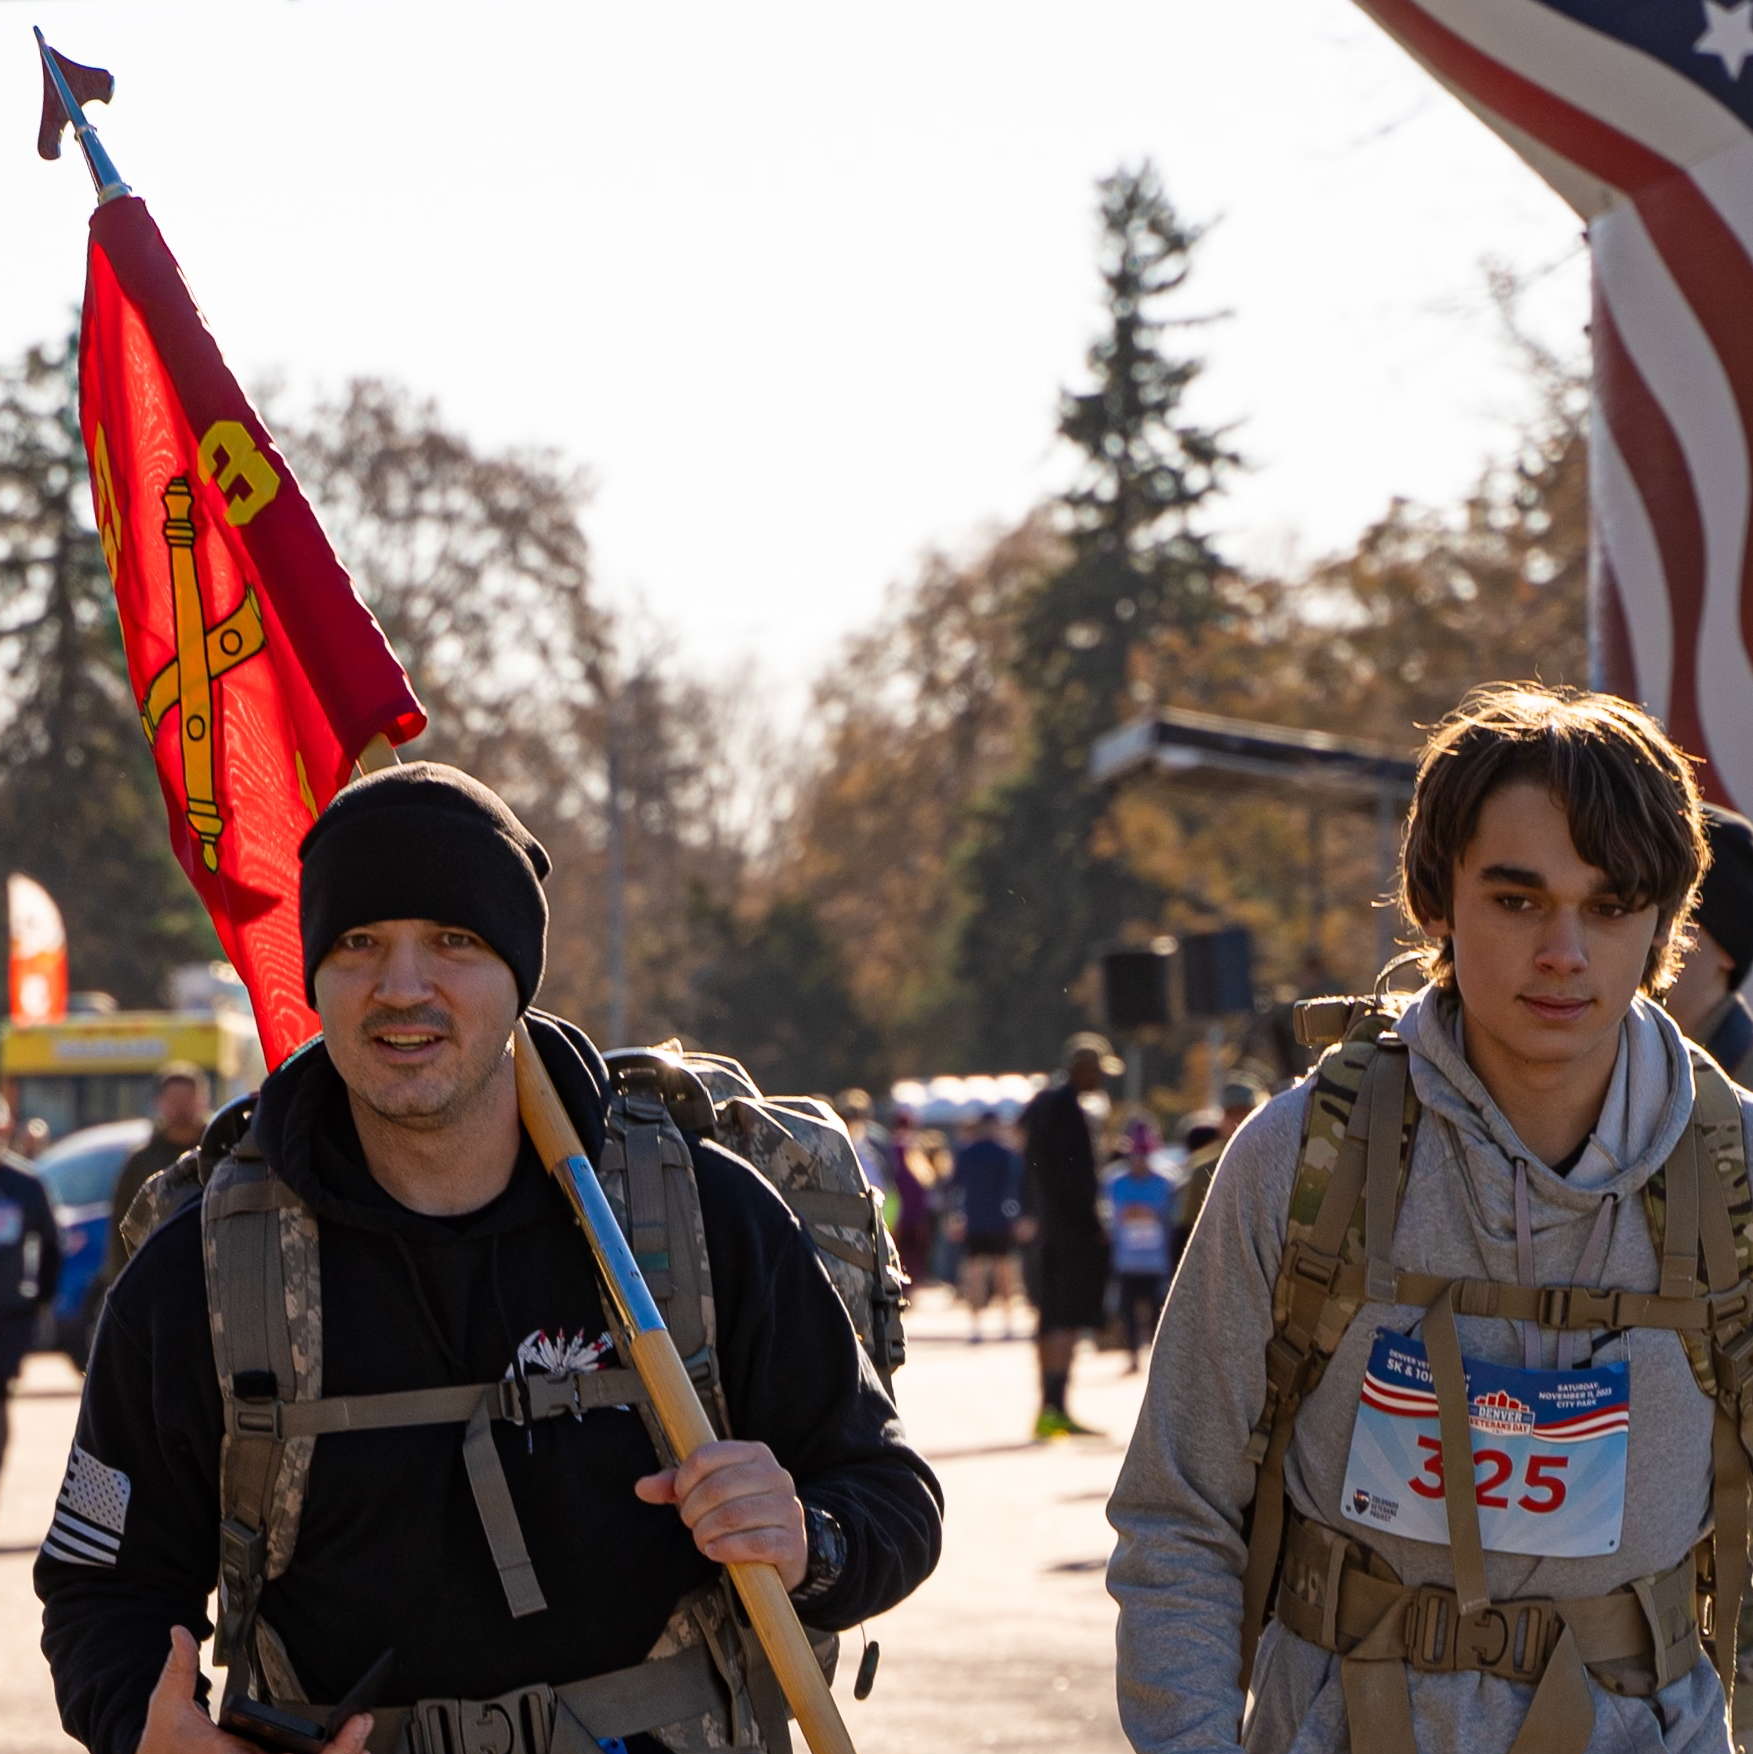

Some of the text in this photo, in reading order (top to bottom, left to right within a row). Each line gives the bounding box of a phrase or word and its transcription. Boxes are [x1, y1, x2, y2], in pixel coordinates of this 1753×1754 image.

[1387, 1358, 1402, 1374] 5K
[1405, 1366, 1412, 1377] &
[1557, 1399, 1574, 1409] CITY
[1478, 1407, 1523, 1422] DENVER
[1469, 1417, 1511, 1430] VETERANS
[1408, 1434, 1569, 1514] 325
